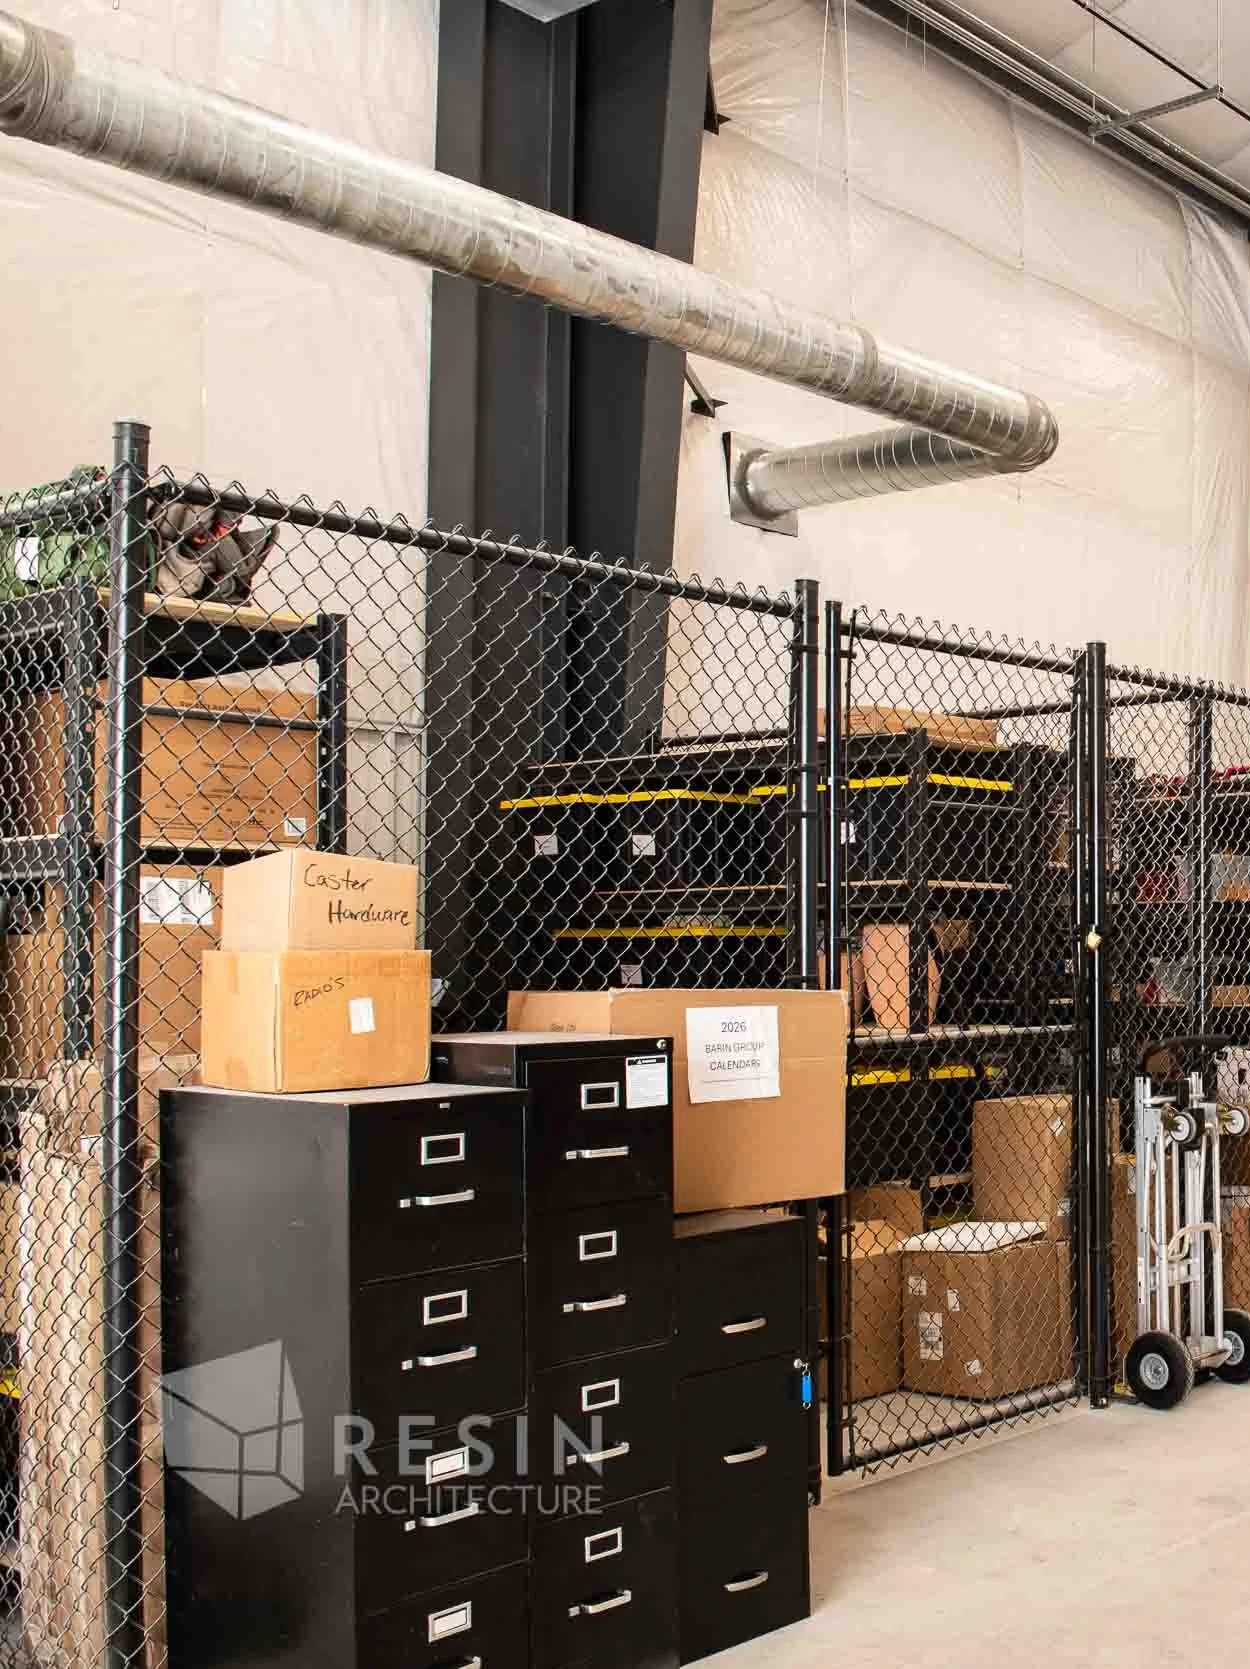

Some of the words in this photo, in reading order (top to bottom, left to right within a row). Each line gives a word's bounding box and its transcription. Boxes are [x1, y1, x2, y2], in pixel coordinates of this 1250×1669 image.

[304, 863, 374, 892] Caster
[328, 899, 412, 926] Hardware
[721, 1021, 747, 1033] 2026
[733, 1041, 765, 1053] GROUP
[710, 1058, 761, 1071] CALENDARS
